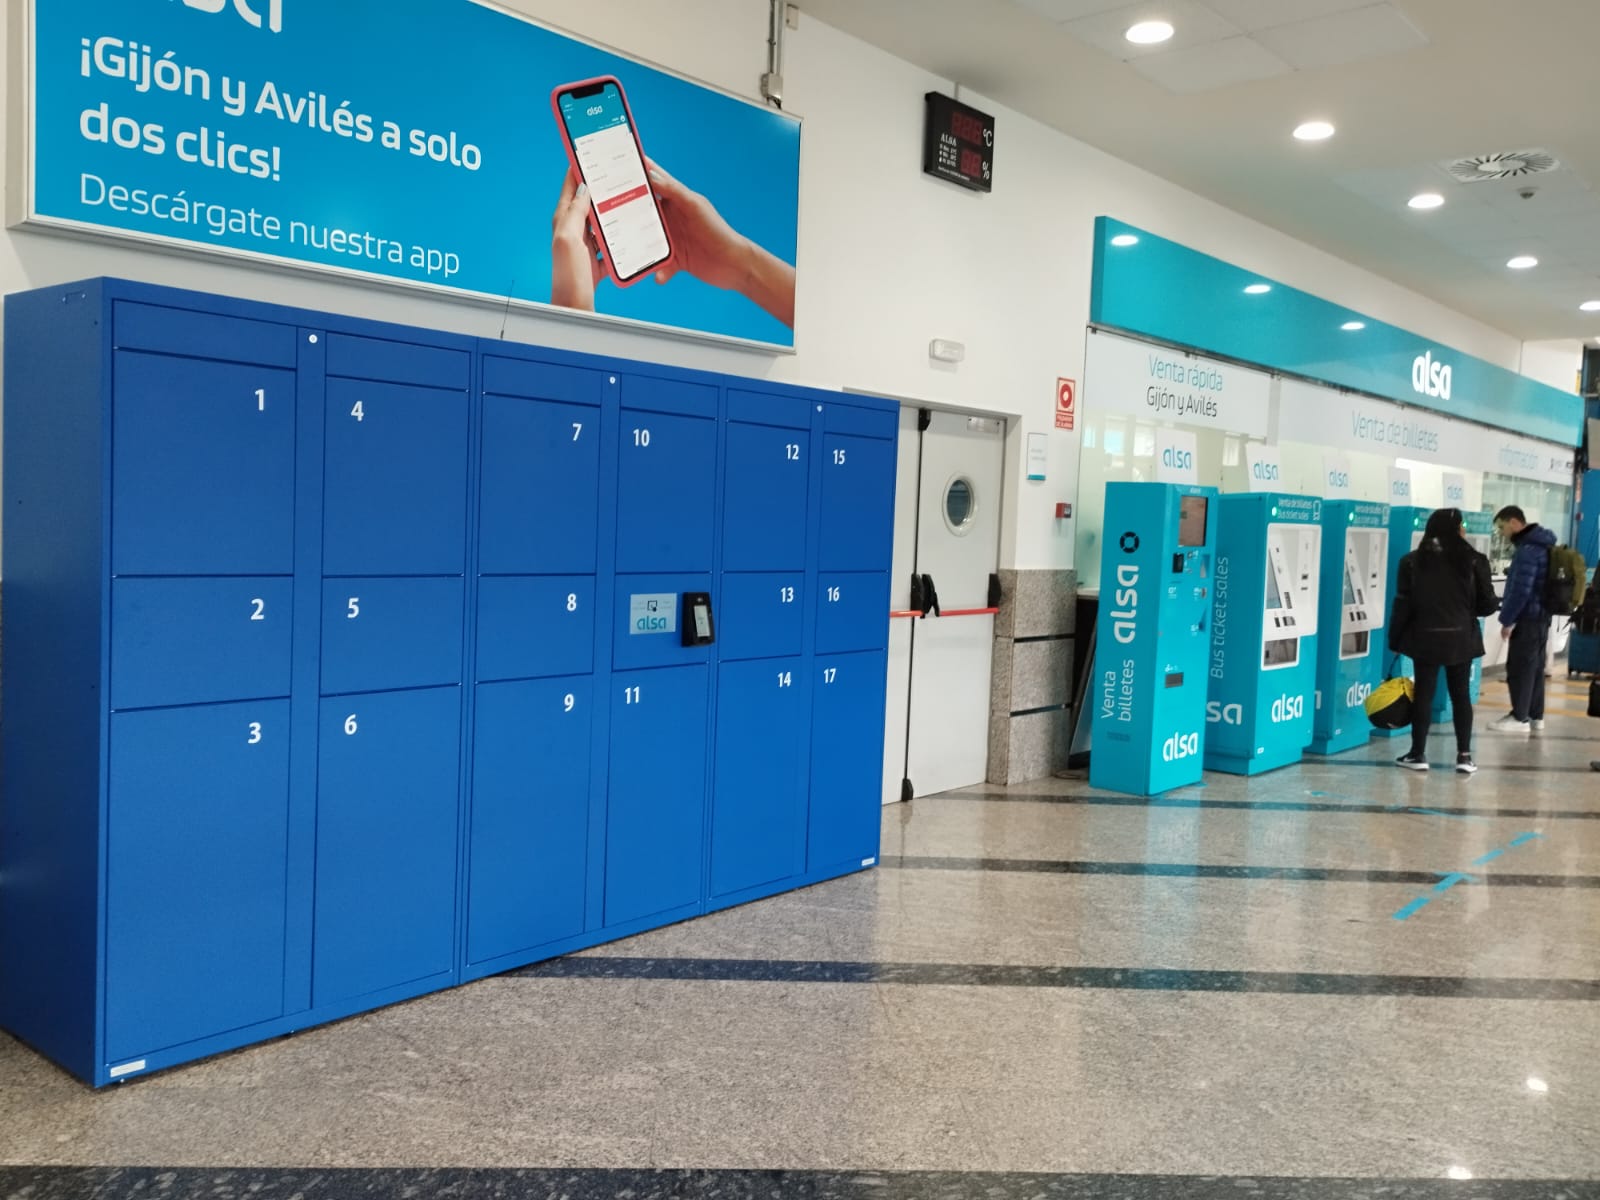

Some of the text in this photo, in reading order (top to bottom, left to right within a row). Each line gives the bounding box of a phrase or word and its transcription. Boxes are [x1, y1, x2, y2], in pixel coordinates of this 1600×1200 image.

[81, 36, 482, 171] ¡Gijón y Avilés a solo
[79, 102, 281, 182] dos clics!
[80, 173, 460, 278] Descárgate nuestra app
[1149, 354, 1223, 392] Venta rápida
[1412, 350, 1452, 401] alsa
[254, 388, 265, 411] 1
[350, 400, 365, 422] 4
[1146, 386, 1218, 418] Gijón y Avilés
[572, 422, 582, 441] 7
[633, 428, 650, 447] 10
[1352, 409, 1440, 452] Venta de billetes
[785, 443, 800, 460] 12
[833, 449, 846, 465] 15
[1162, 445, 1192, 470] alsa
[1253, 460, 1279, 480] alsa
[1329, 468, 1349, 488] alsa
[566, 593, 577, 612] 8
[780, 586, 794, 603] 13
[827, 586, 840, 602] 16
[1110, 564, 1140, 644] alsa
[250, 598, 265, 621] 2
[347, 597, 360, 619] 5
[1210, 556, 1229, 679] Bus ticket sales
[636, 616, 667, 631] alsa
[777, 671, 792, 688] 14
[823, 667, 837, 684] 17
[624, 686, 640, 705] 11
[1101, 671, 1117, 719] Venta
[1118, 659, 1134, 722] billetes
[563, 693, 575, 712] 9
[1271, 693, 1303, 723] alsa
[247, 721, 262, 744] 3
[344, 713, 358, 736] 6
[1162, 732, 1199, 762] alsa
